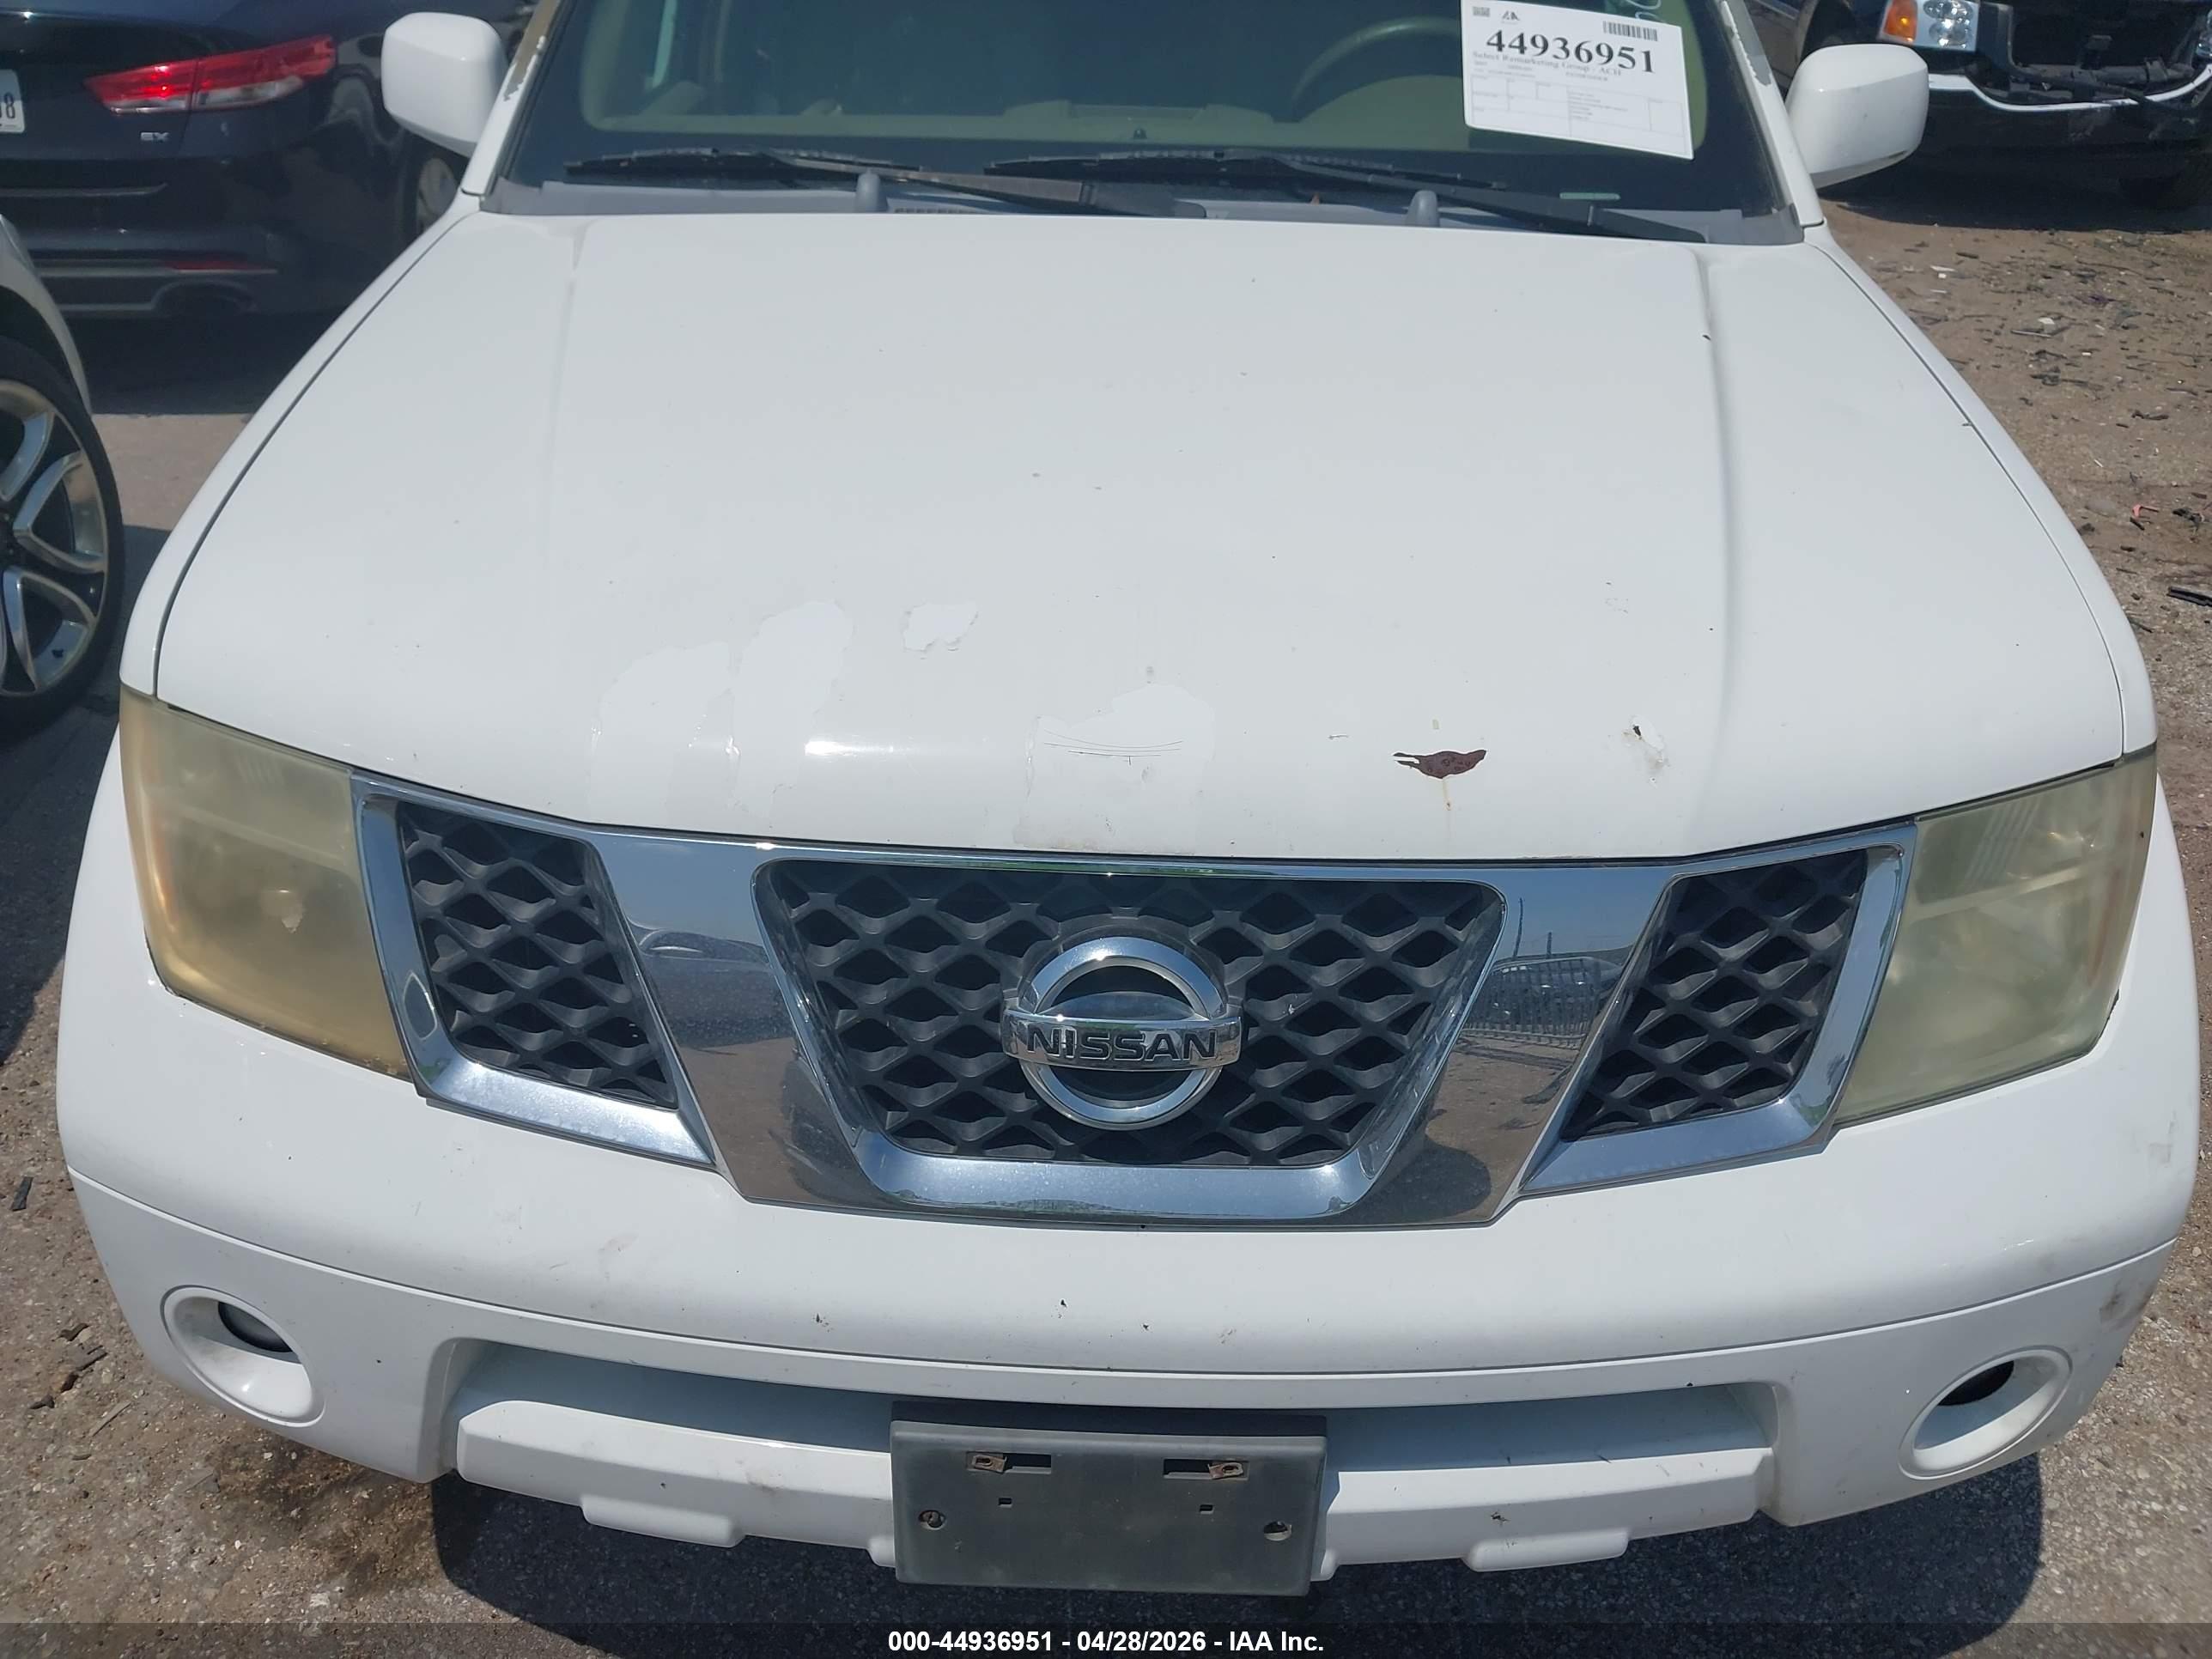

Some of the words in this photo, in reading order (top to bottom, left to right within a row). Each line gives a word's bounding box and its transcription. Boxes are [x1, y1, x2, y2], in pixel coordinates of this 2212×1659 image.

[1486, 29, 1656, 74] 44936951
[140, 131, 169, 143] EX
[1027, 1026, 1216, 1062] NISSAN
